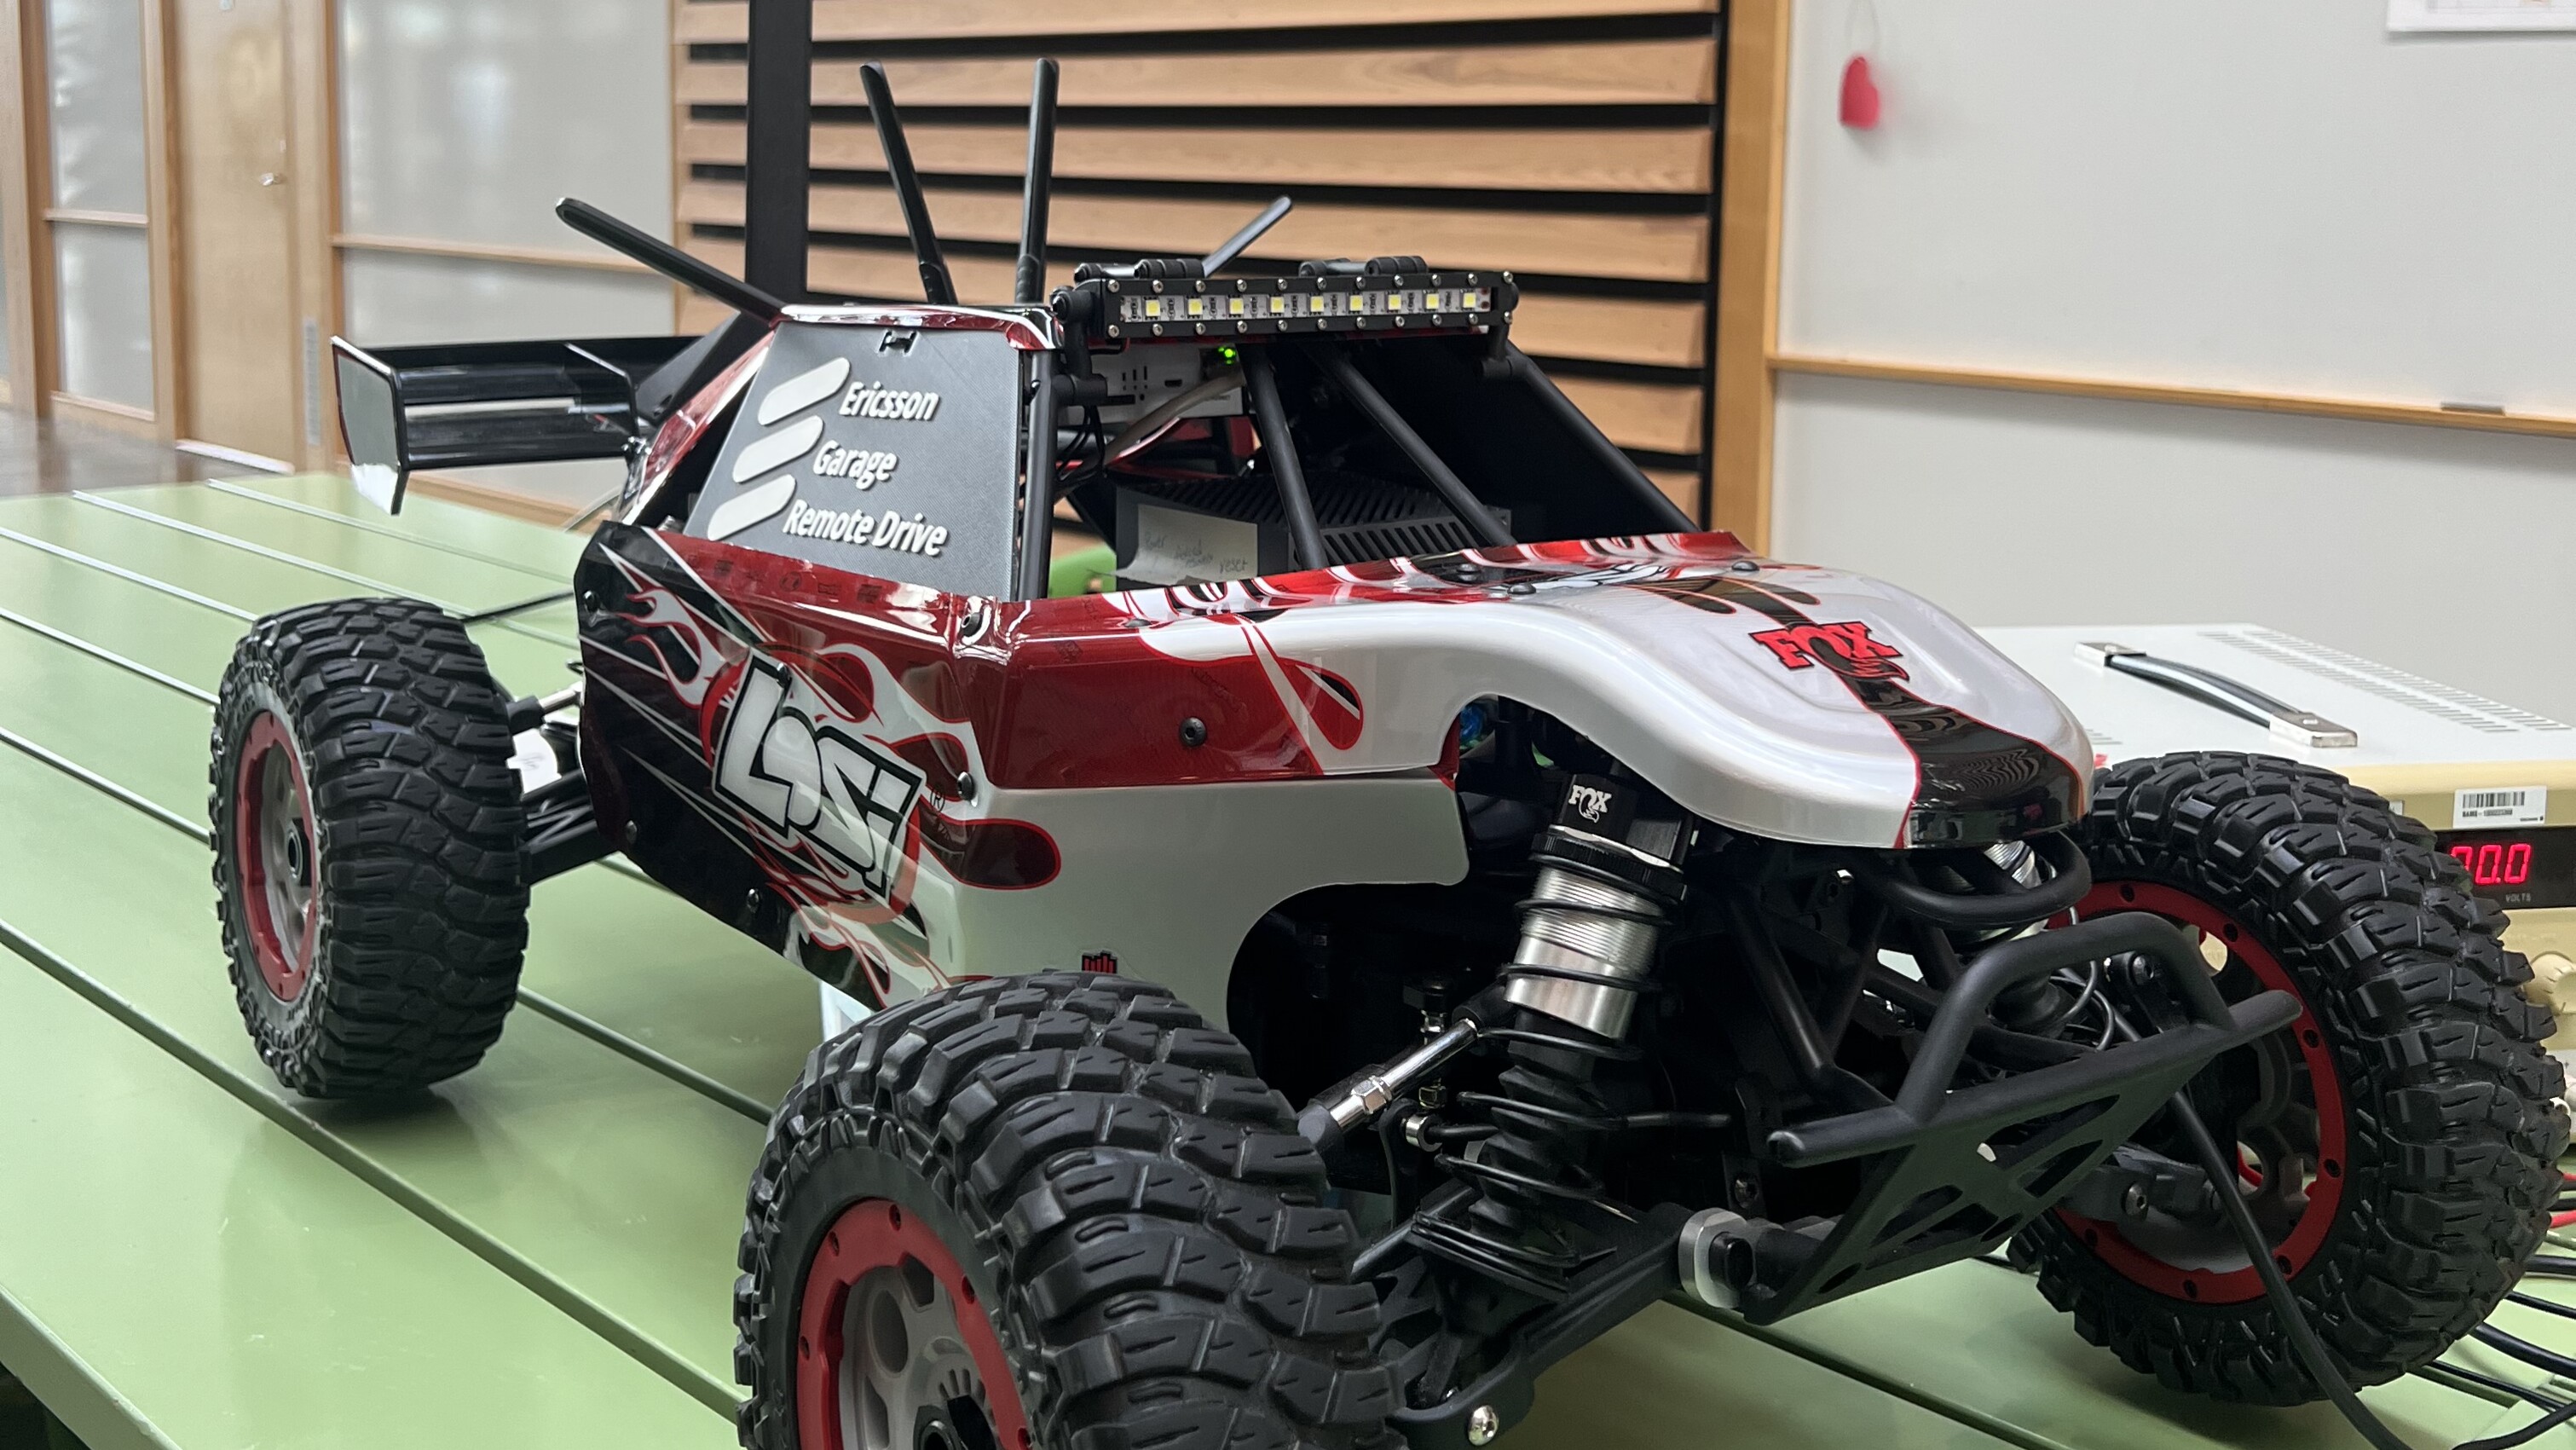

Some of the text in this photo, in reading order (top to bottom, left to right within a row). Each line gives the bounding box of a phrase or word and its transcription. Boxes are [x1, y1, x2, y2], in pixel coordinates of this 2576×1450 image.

[839, 380, 939, 421] Ericsson
[812, 439, 898, 490] Garage
[783, 499, 949, 557] Remote Drive
[1747, 620, 1910, 683] FOX
[1568, 784, 1613, 823] FOX
[2504, 892, 2533, 903] VOLTS
